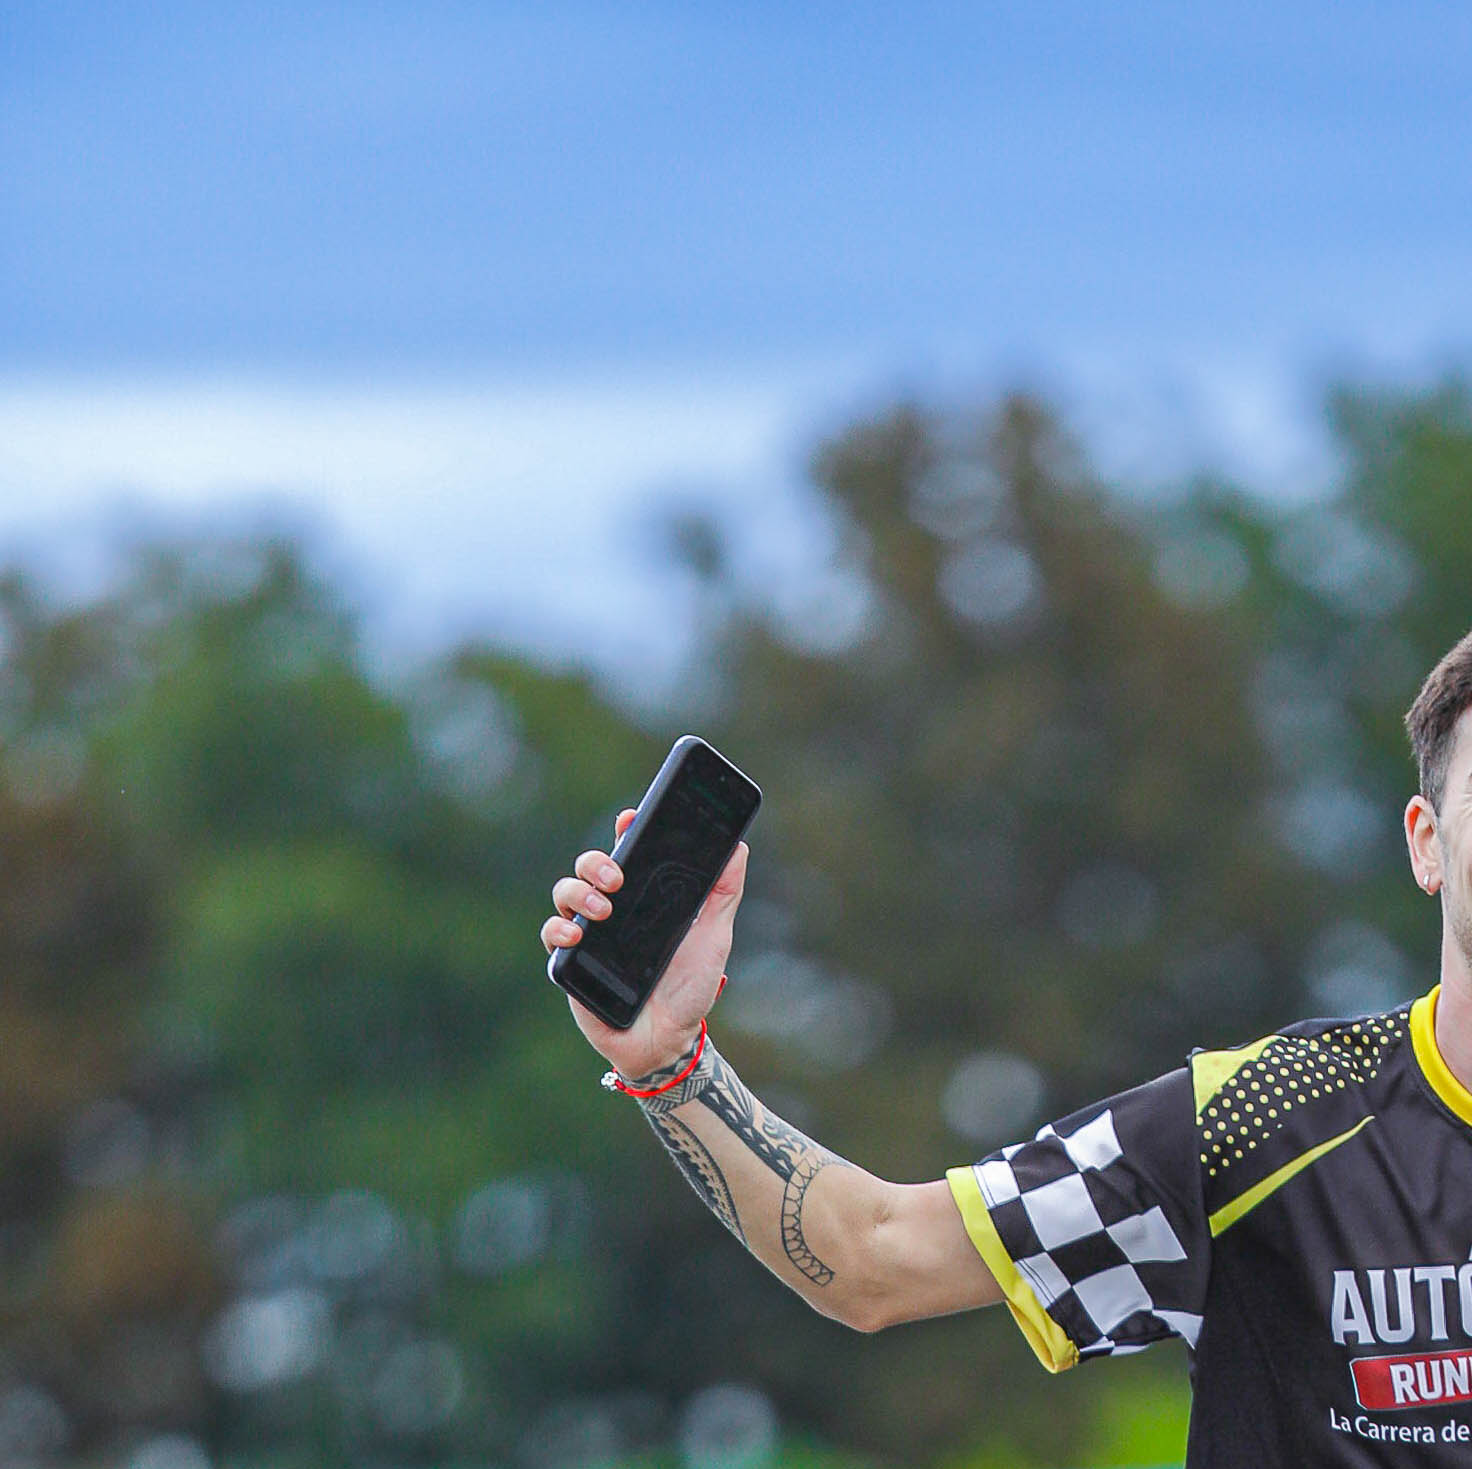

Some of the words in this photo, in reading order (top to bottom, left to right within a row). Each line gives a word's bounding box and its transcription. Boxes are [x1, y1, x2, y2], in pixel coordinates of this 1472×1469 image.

[1329, 1407, 1352, 1433] La
[1354, 1415, 1436, 1444] Carrera
[1441, 1419, 1470, 1443] de
